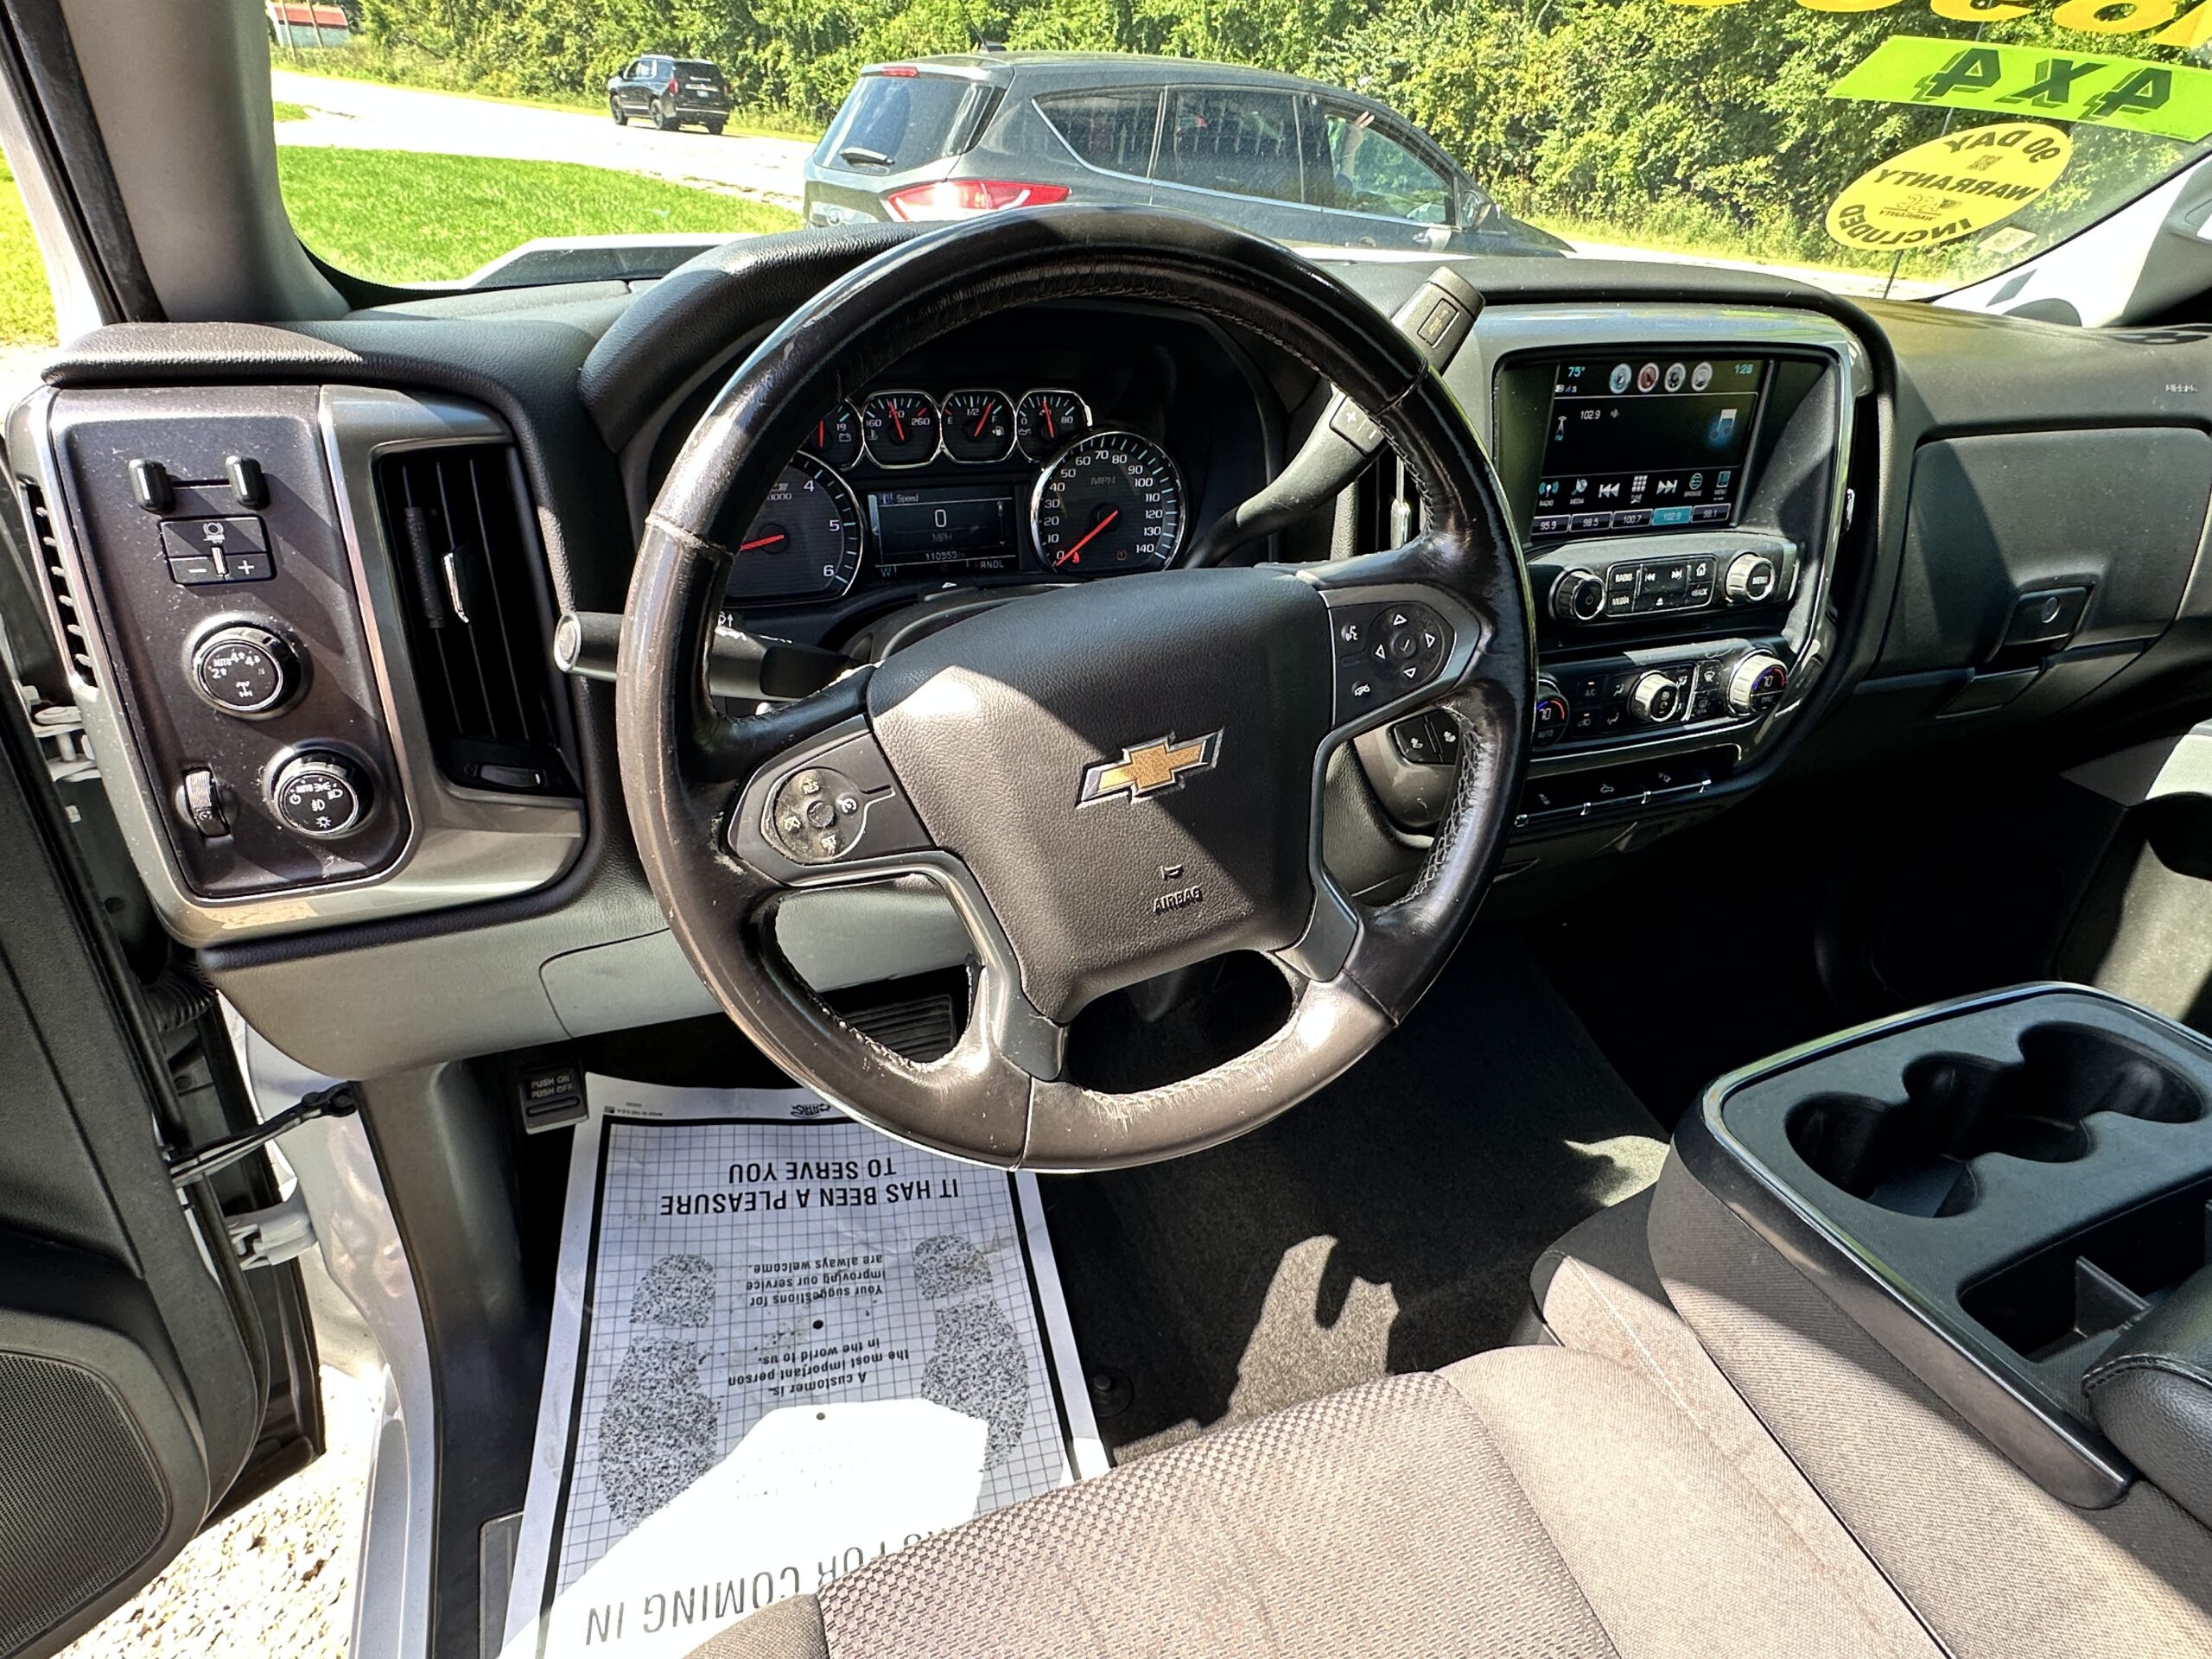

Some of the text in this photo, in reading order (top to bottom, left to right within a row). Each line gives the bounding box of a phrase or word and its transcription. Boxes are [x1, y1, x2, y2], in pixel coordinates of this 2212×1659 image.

[911, 417, 931, 426] 260
[1060, 416, 1074, 424] 80
[836, 423, 847, 432] 19
[1095, 449, 1109, 460] 70
[1111, 454, 1128, 464] 80
[1075, 456, 1090, 466] 60
[1060, 468, 1077, 478] 50
[1128, 465, 1143, 474] 90
[803, 480, 815, 493] 4
[1049, 482, 1065, 492] 40
[1134, 478, 1154, 487] 100
[1044, 499, 1060, 508] 30
[1145, 493, 1160, 502] 110
[934, 509, 947, 528] 0
[1145, 509, 1163, 518] 120
[829, 519, 840, 531] 5
[1043, 516, 1059, 526] 20
[1143, 526, 1161, 536] 130
[1047, 533, 1059, 543] 10
[1135, 543, 1154, 553] 140
[823, 564, 835, 576] 6
[1153, 884, 1204, 914] AIRBAG
[531, 1074, 570, 1089] PUSH ON
[531, 1084, 574, 1099] PUSH OFF
[728, 1156, 896, 1183] TO SERVE YOU
[660, 1178, 959, 1217] IT HAS BEEN A PLEASURE
[815, 1256, 858, 1271] always
[862, 1254, 883, 1266] are
[746, 1268, 886, 1292] improving our service
[749, 1284, 883, 1307] Your suggestions for
[842, 1342, 863, 1354] the
[868, 1338, 880, 1350] in
[783, 1352, 796, 1363] to
[800, 1346, 838, 1363] world
[728, 1349, 910, 1388] the most important person
[857, 1371, 867, 1383] A
[789, 1374, 853, 1394] customer
[586, 1602, 625, 1647] IN
